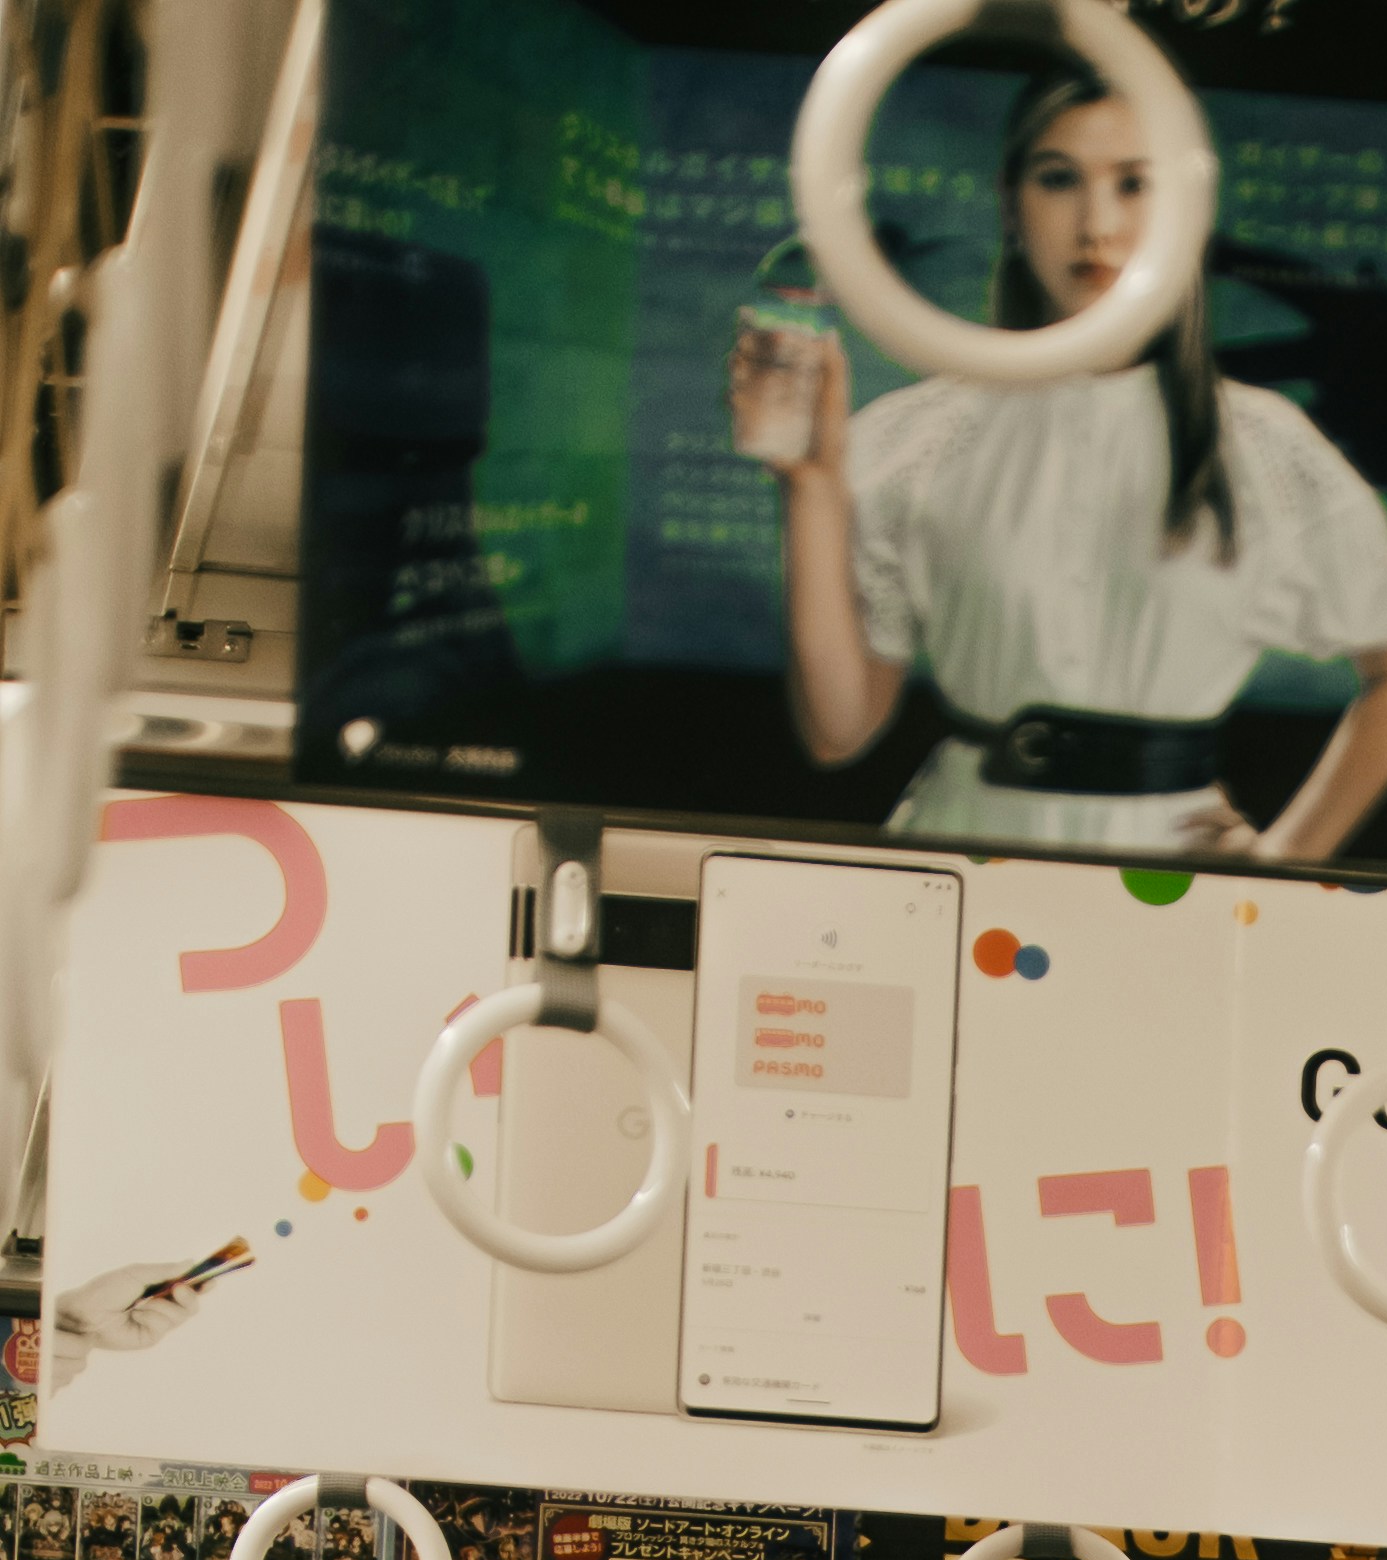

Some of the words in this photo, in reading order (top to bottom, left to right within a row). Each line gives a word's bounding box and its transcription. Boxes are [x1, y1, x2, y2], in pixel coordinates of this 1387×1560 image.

[752, 1059, 825, 1079] PASMO
[34, 1460, 248, 1491] 過去作品上映・一気見上映会
[636, 1518, 791, 1542] ソードアート・オンライン
